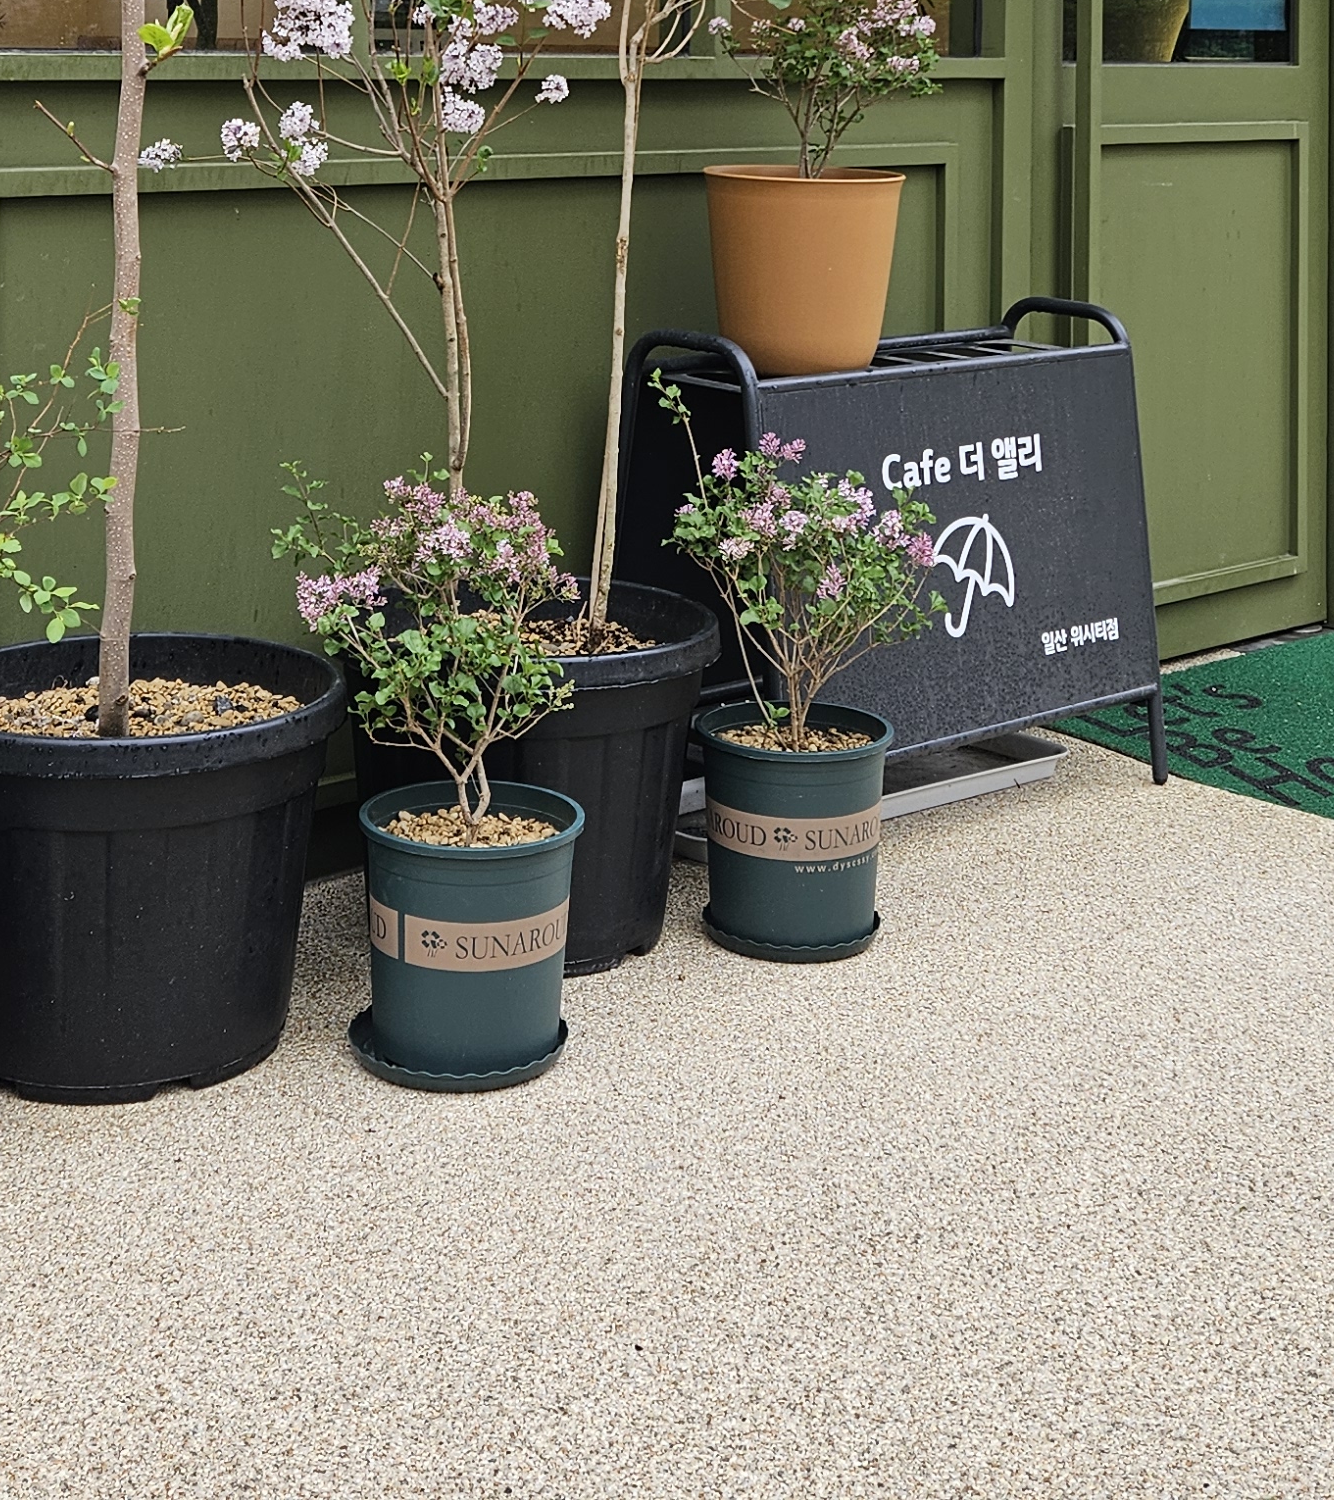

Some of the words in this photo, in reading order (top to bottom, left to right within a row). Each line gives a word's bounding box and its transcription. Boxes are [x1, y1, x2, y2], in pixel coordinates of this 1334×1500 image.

[882, 449, 951, 491] Cafe
[960, 443, 985, 483] 더
[990, 433, 1043, 481] 앨리
[1041, 629, 1068, 656] 일산
[1069, 618, 1120, 648] 위시티점
[1143, 727, 1282, 768] Be
